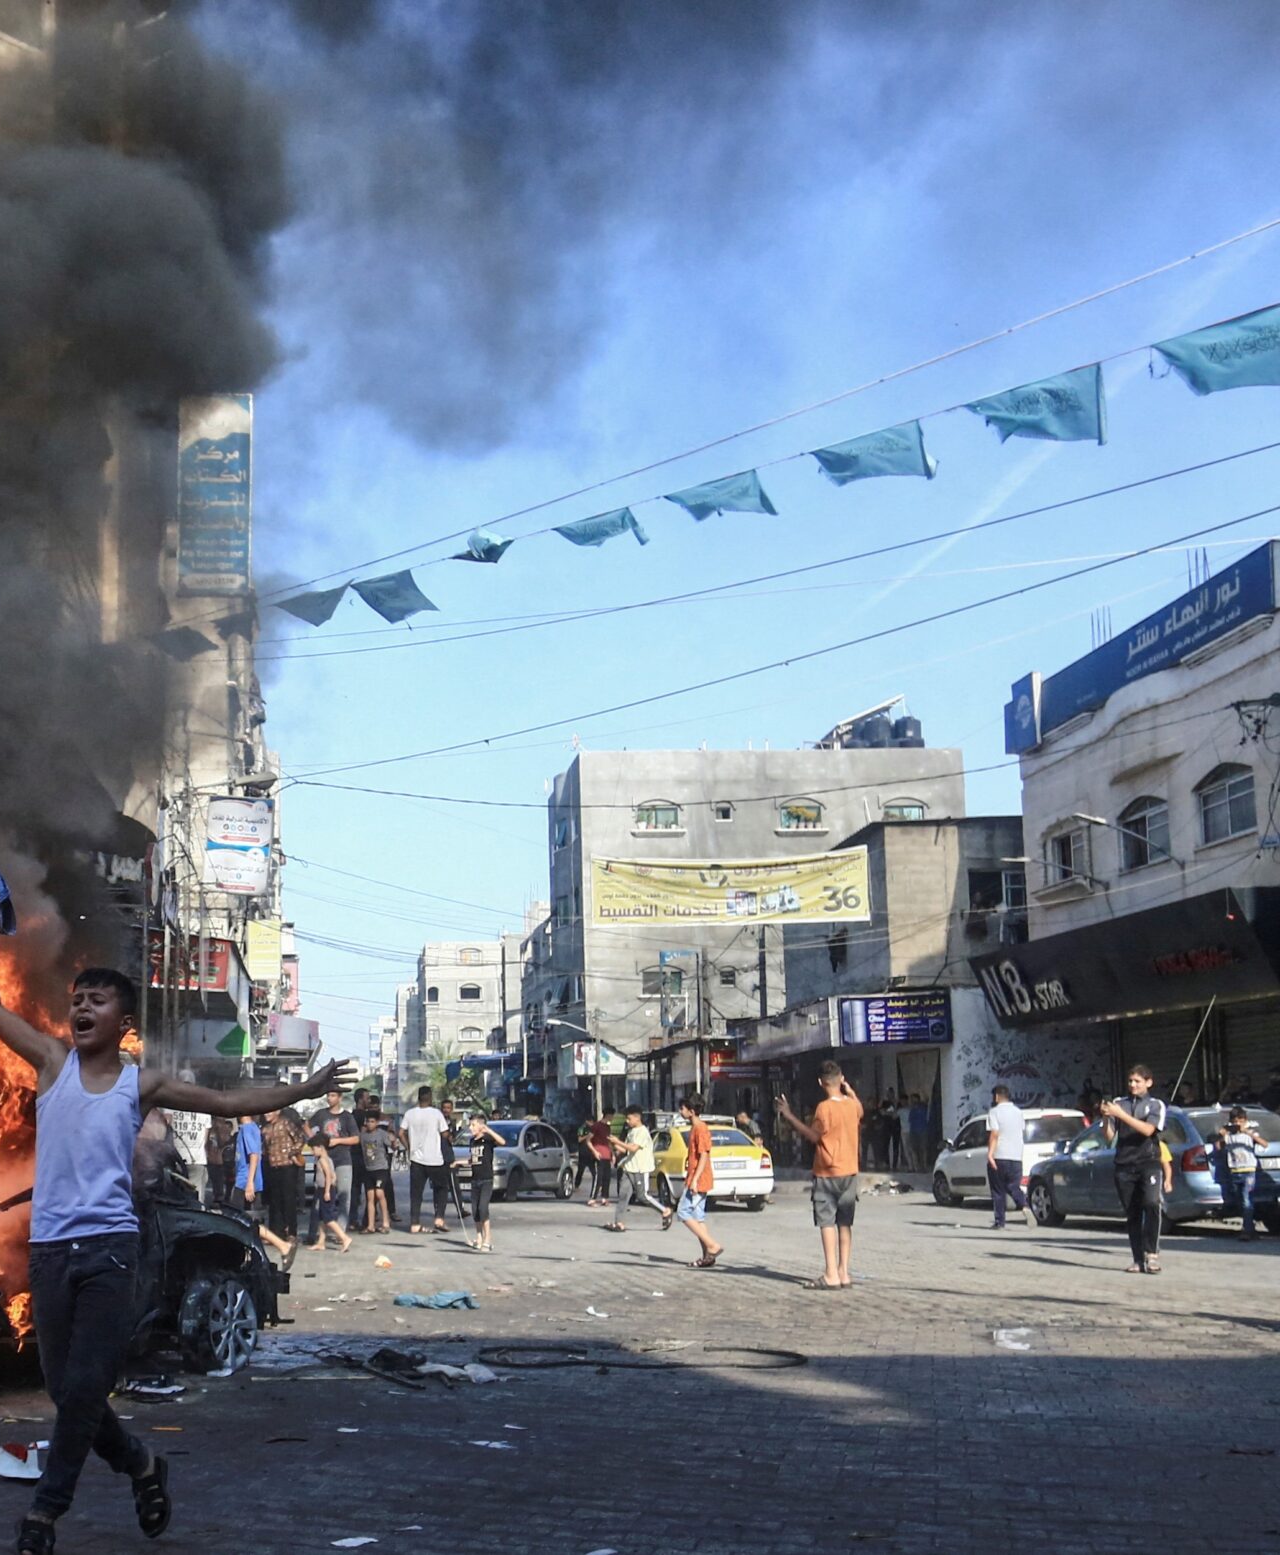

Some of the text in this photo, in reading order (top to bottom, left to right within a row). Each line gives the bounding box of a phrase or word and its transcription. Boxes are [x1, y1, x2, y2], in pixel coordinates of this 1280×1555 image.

[194, 445, 240, 463] مركز
[1213, 568, 1240, 614] نور
[1163, 587, 1209, 638] البهاء
[599, 904, 658, 922] التقسيط
[822, 884, 862, 913] 36
[1035, 981, 1070, 1010] STAR
